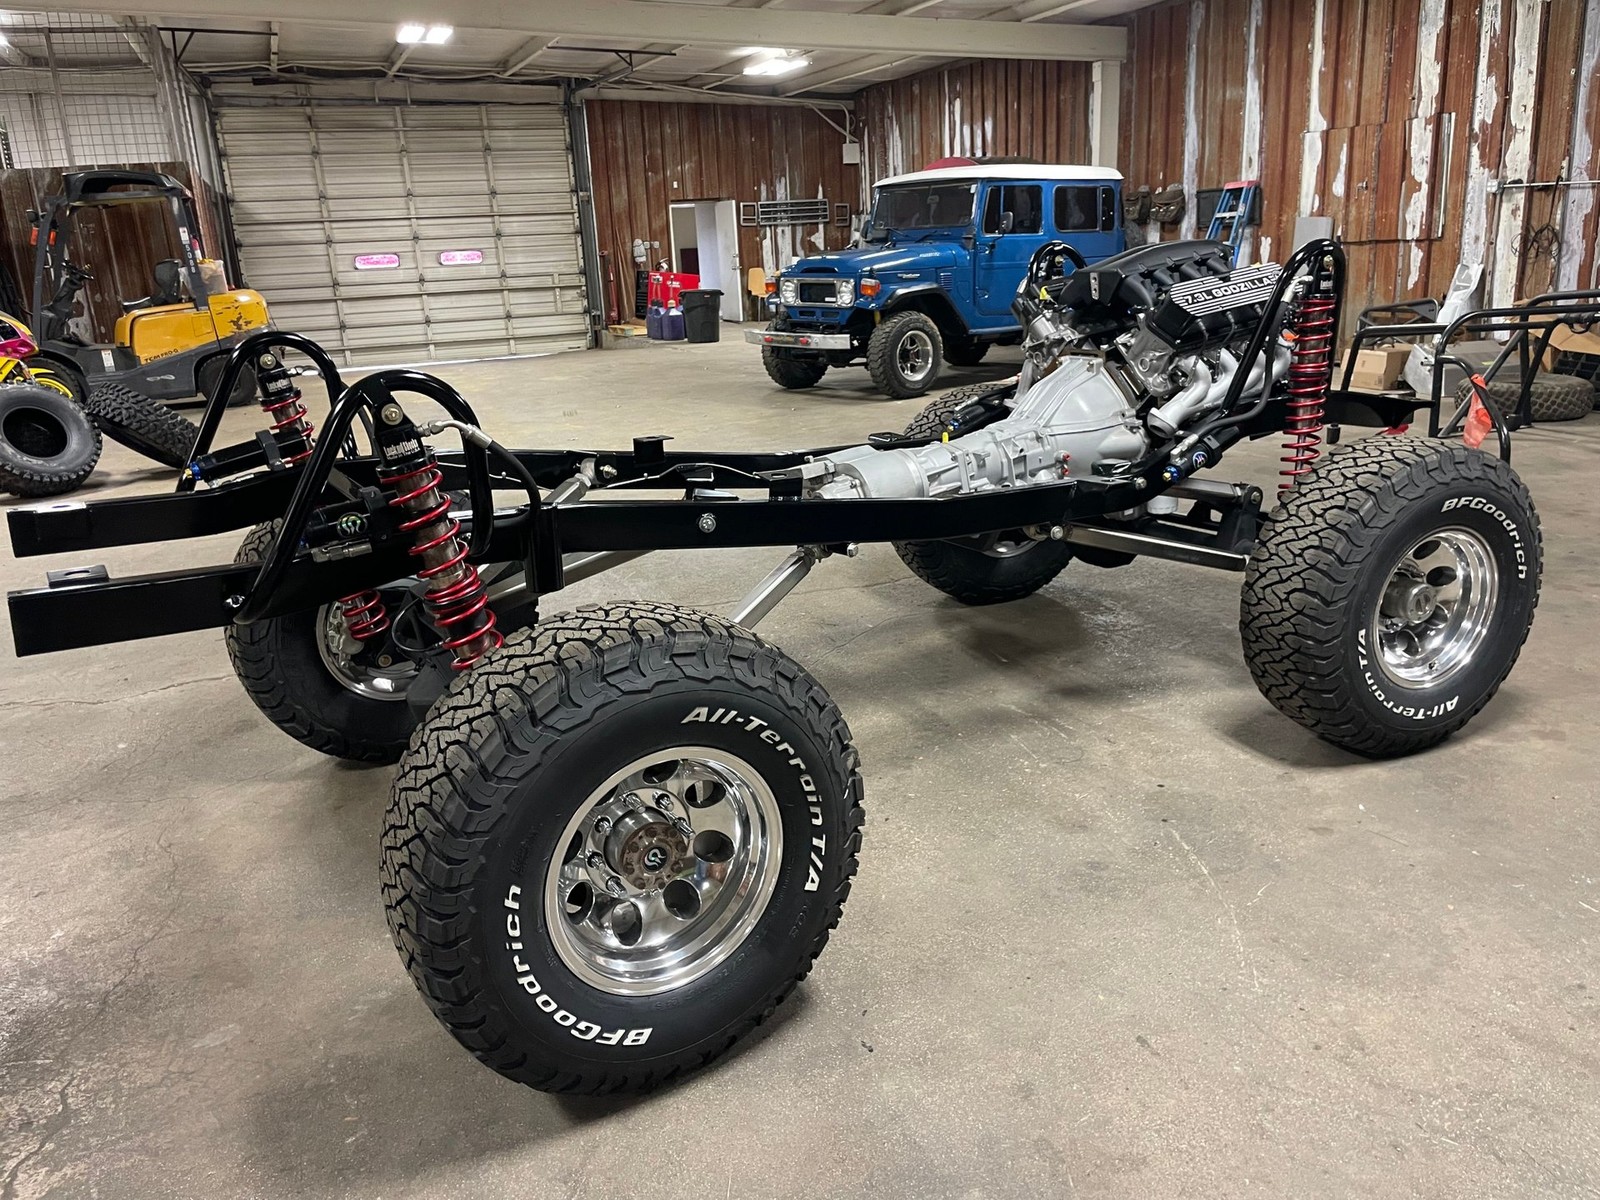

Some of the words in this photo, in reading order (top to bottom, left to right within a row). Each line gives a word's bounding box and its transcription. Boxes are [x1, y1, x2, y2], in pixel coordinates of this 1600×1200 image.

[1184, 290, 1213, 305] 7.3L
[1211, 275, 1273, 298] GODZILLA
[1441, 496, 1528, 580] BFGoodrich
[1357, 628, 1369, 670] T/A
[1364, 669, 1459, 720] All-Terrain
[681, 706, 824, 829] All-Terrain
[803, 833, 827, 892] T/A
[504, 884, 653, 1046] BFGoodrich
